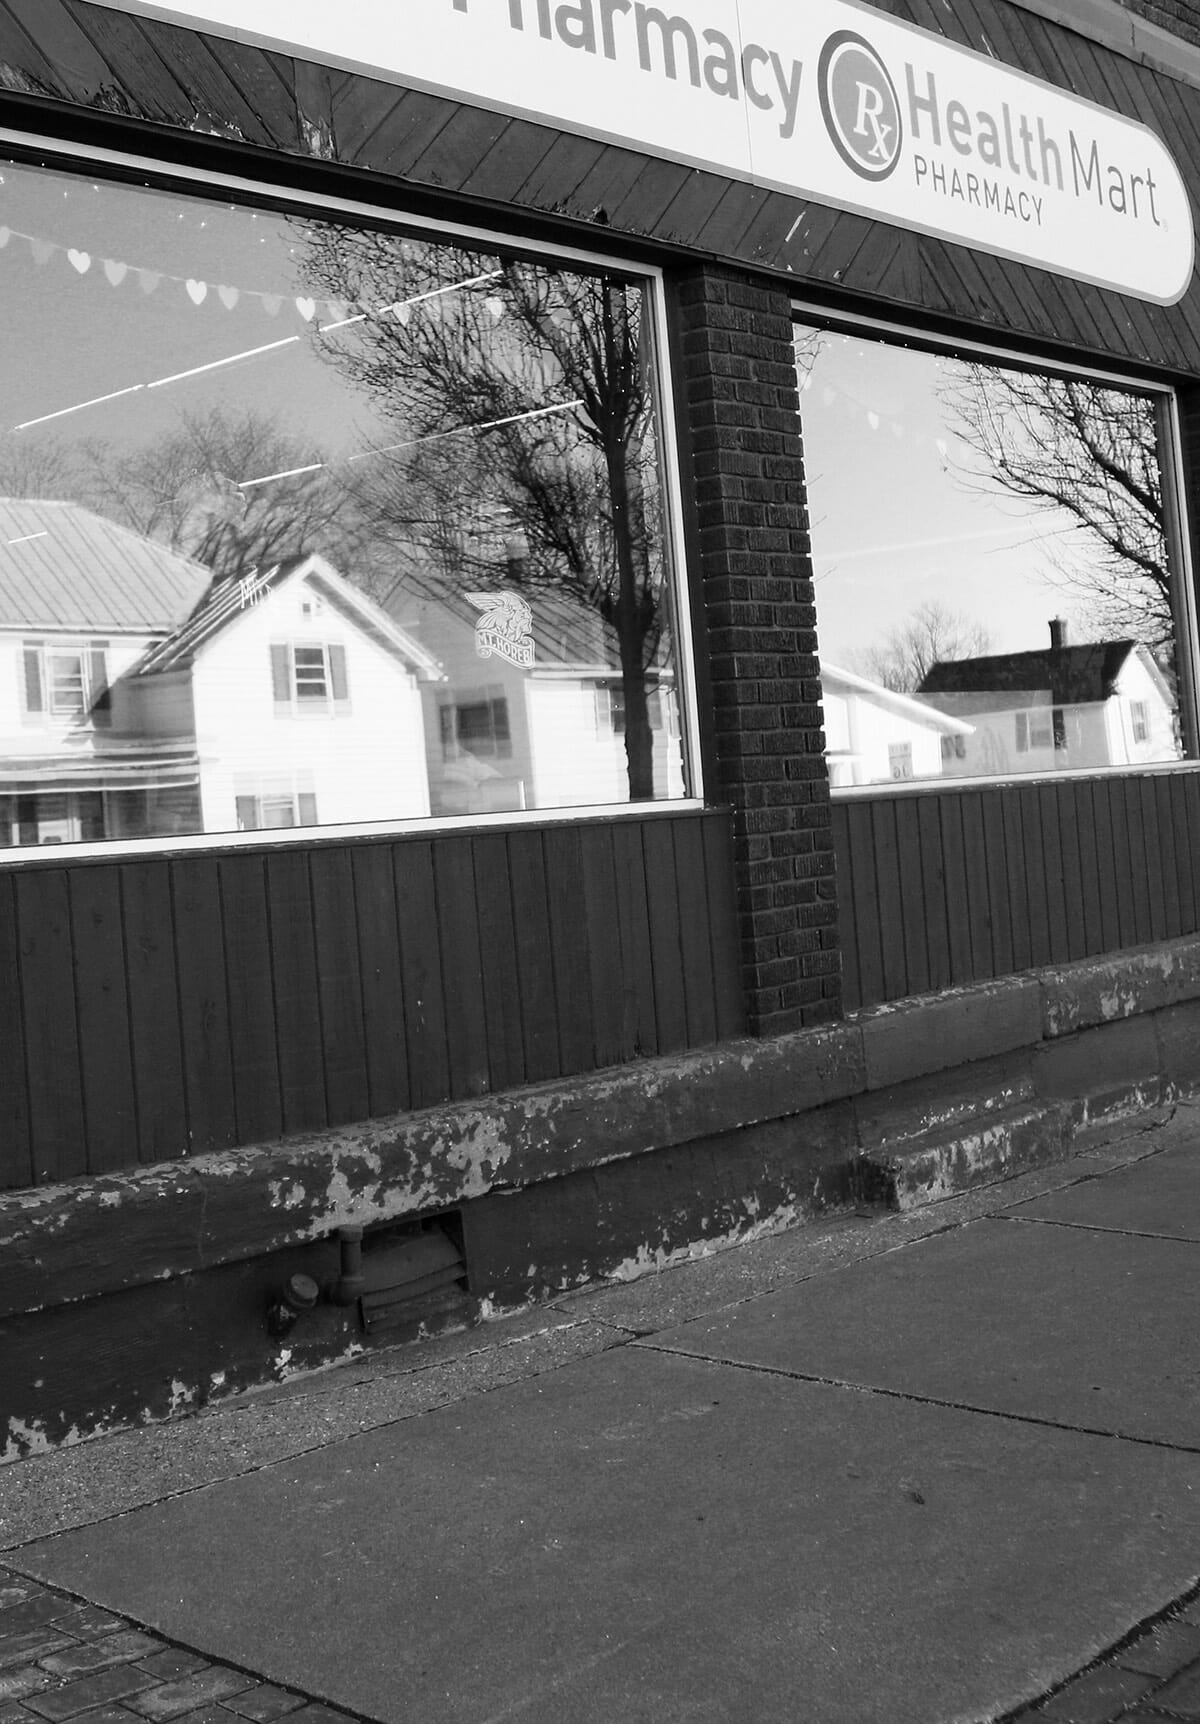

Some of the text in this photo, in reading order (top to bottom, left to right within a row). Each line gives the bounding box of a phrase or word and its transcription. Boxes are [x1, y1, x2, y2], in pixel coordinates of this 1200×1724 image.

[452, 0, 803, 139] armacy
[904, 62, 1160, 226] Health Mart
[914, 154, 1043, 226] PHARMACY
